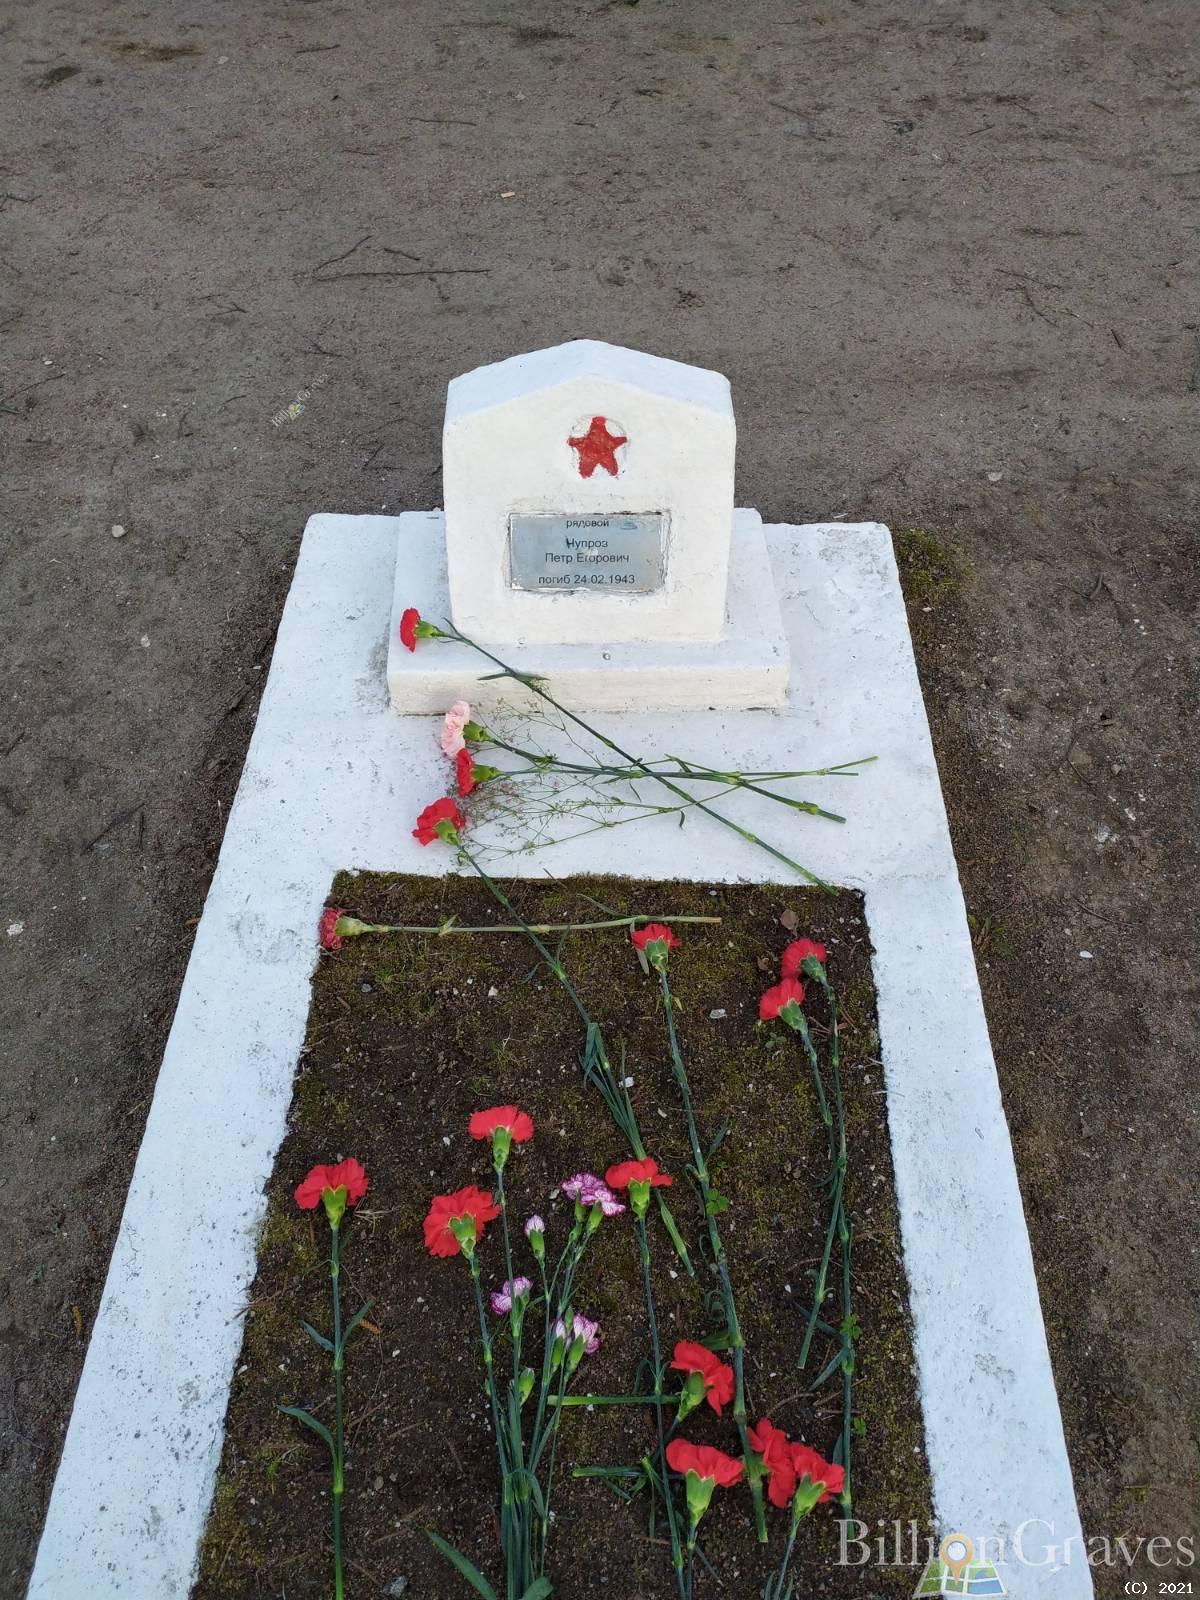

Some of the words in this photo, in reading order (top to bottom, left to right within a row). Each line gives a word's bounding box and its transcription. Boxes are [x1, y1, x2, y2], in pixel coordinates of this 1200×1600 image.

[566, 518, 609, 529] рядовой
[545, 552, 573, 564] Петр
[577, 552, 629, 564] Егорович
[538, 574, 570, 584] погиб
[574, 574, 635, 584] 24.02.1943
